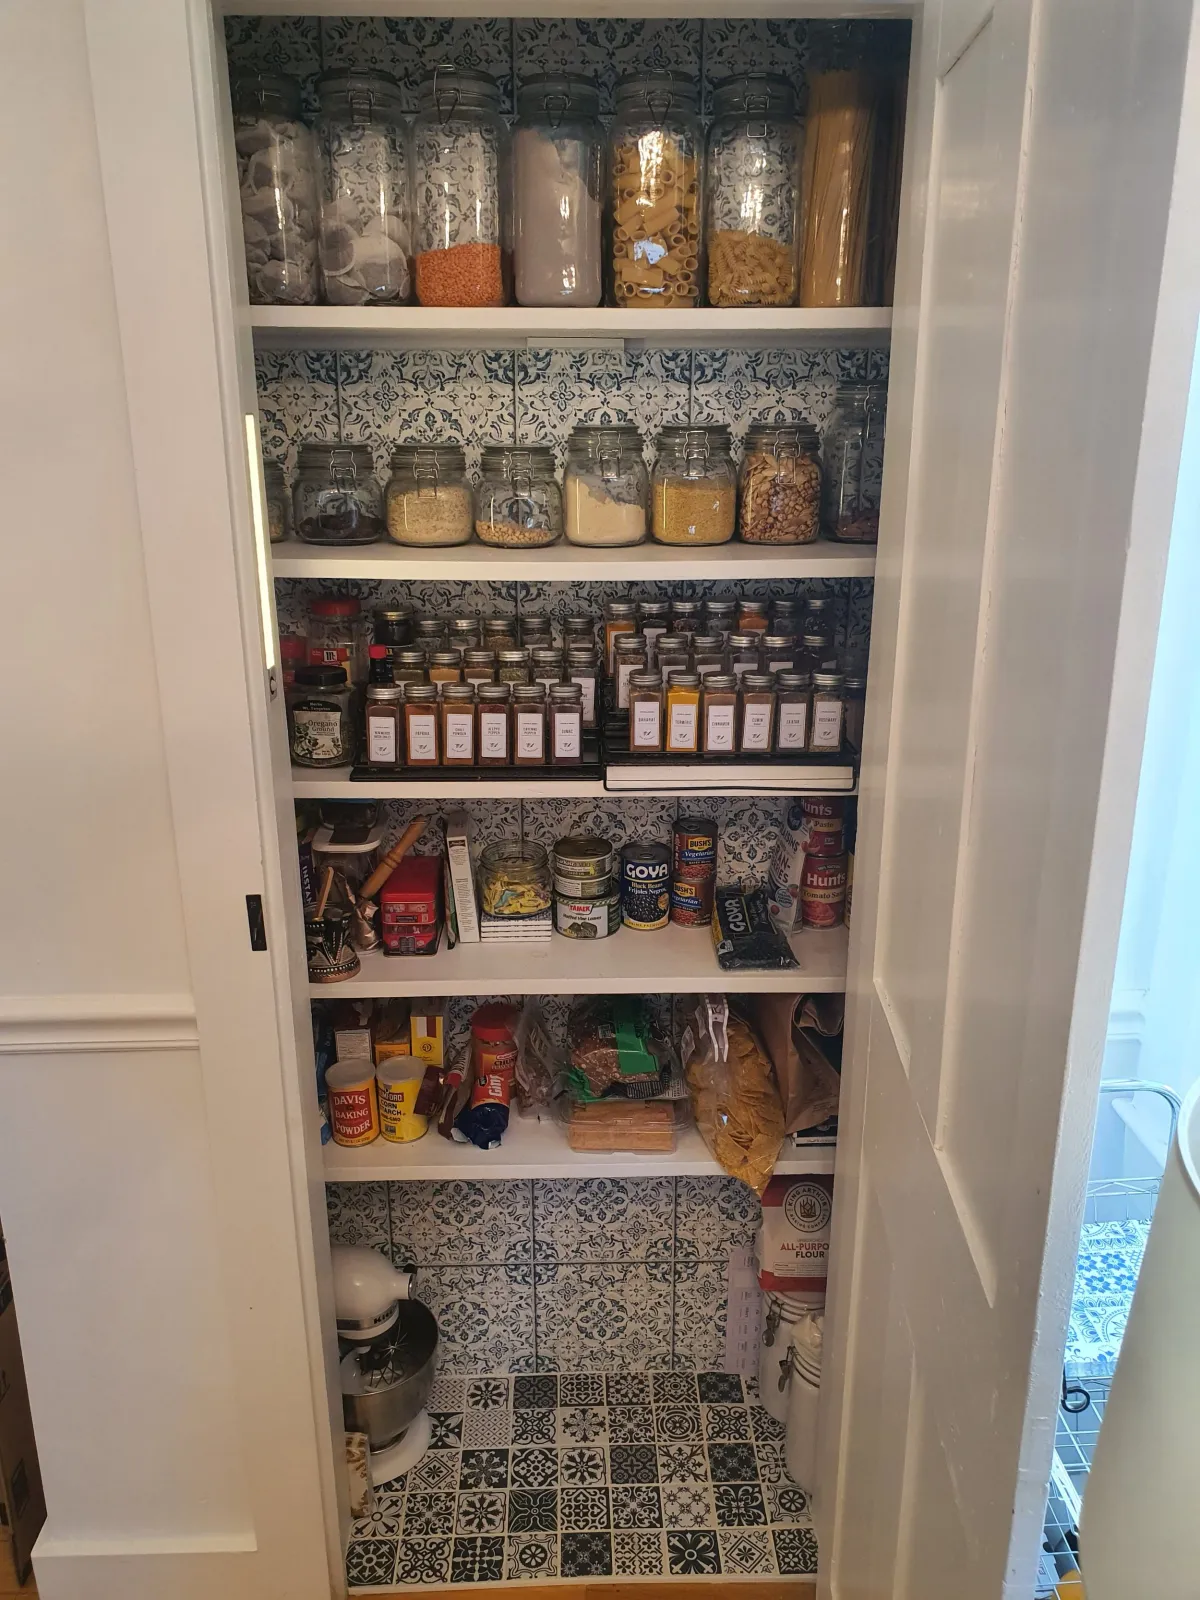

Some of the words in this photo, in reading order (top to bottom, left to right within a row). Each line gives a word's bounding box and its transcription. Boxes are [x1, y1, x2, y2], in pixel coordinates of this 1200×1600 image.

[308, 720, 338, 728] Oregano
[814, 820, 834, 828] Paste
[690, 840, 712, 848] BUSH'S
[684, 849, 715, 858] Vegetarian
[626, 863, 668, 879] GOYA
[632, 881, 647, 889] Black
[628, 886, 648, 895] Frijoles
[570, 904, 591, 912] TAMEK
[724, 898, 747, 932] GOYA
[334, 1094, 366, 1106] DAVIS
[335, 1107, 369, 1120] BAKING
[335, 1119, 371, 1135] POWDER
[788, 1190, 802, 1207] KING
[802, 1187, 828, 1208] ARTHUR
[795, 1250, 825, 1259] FLOUR
